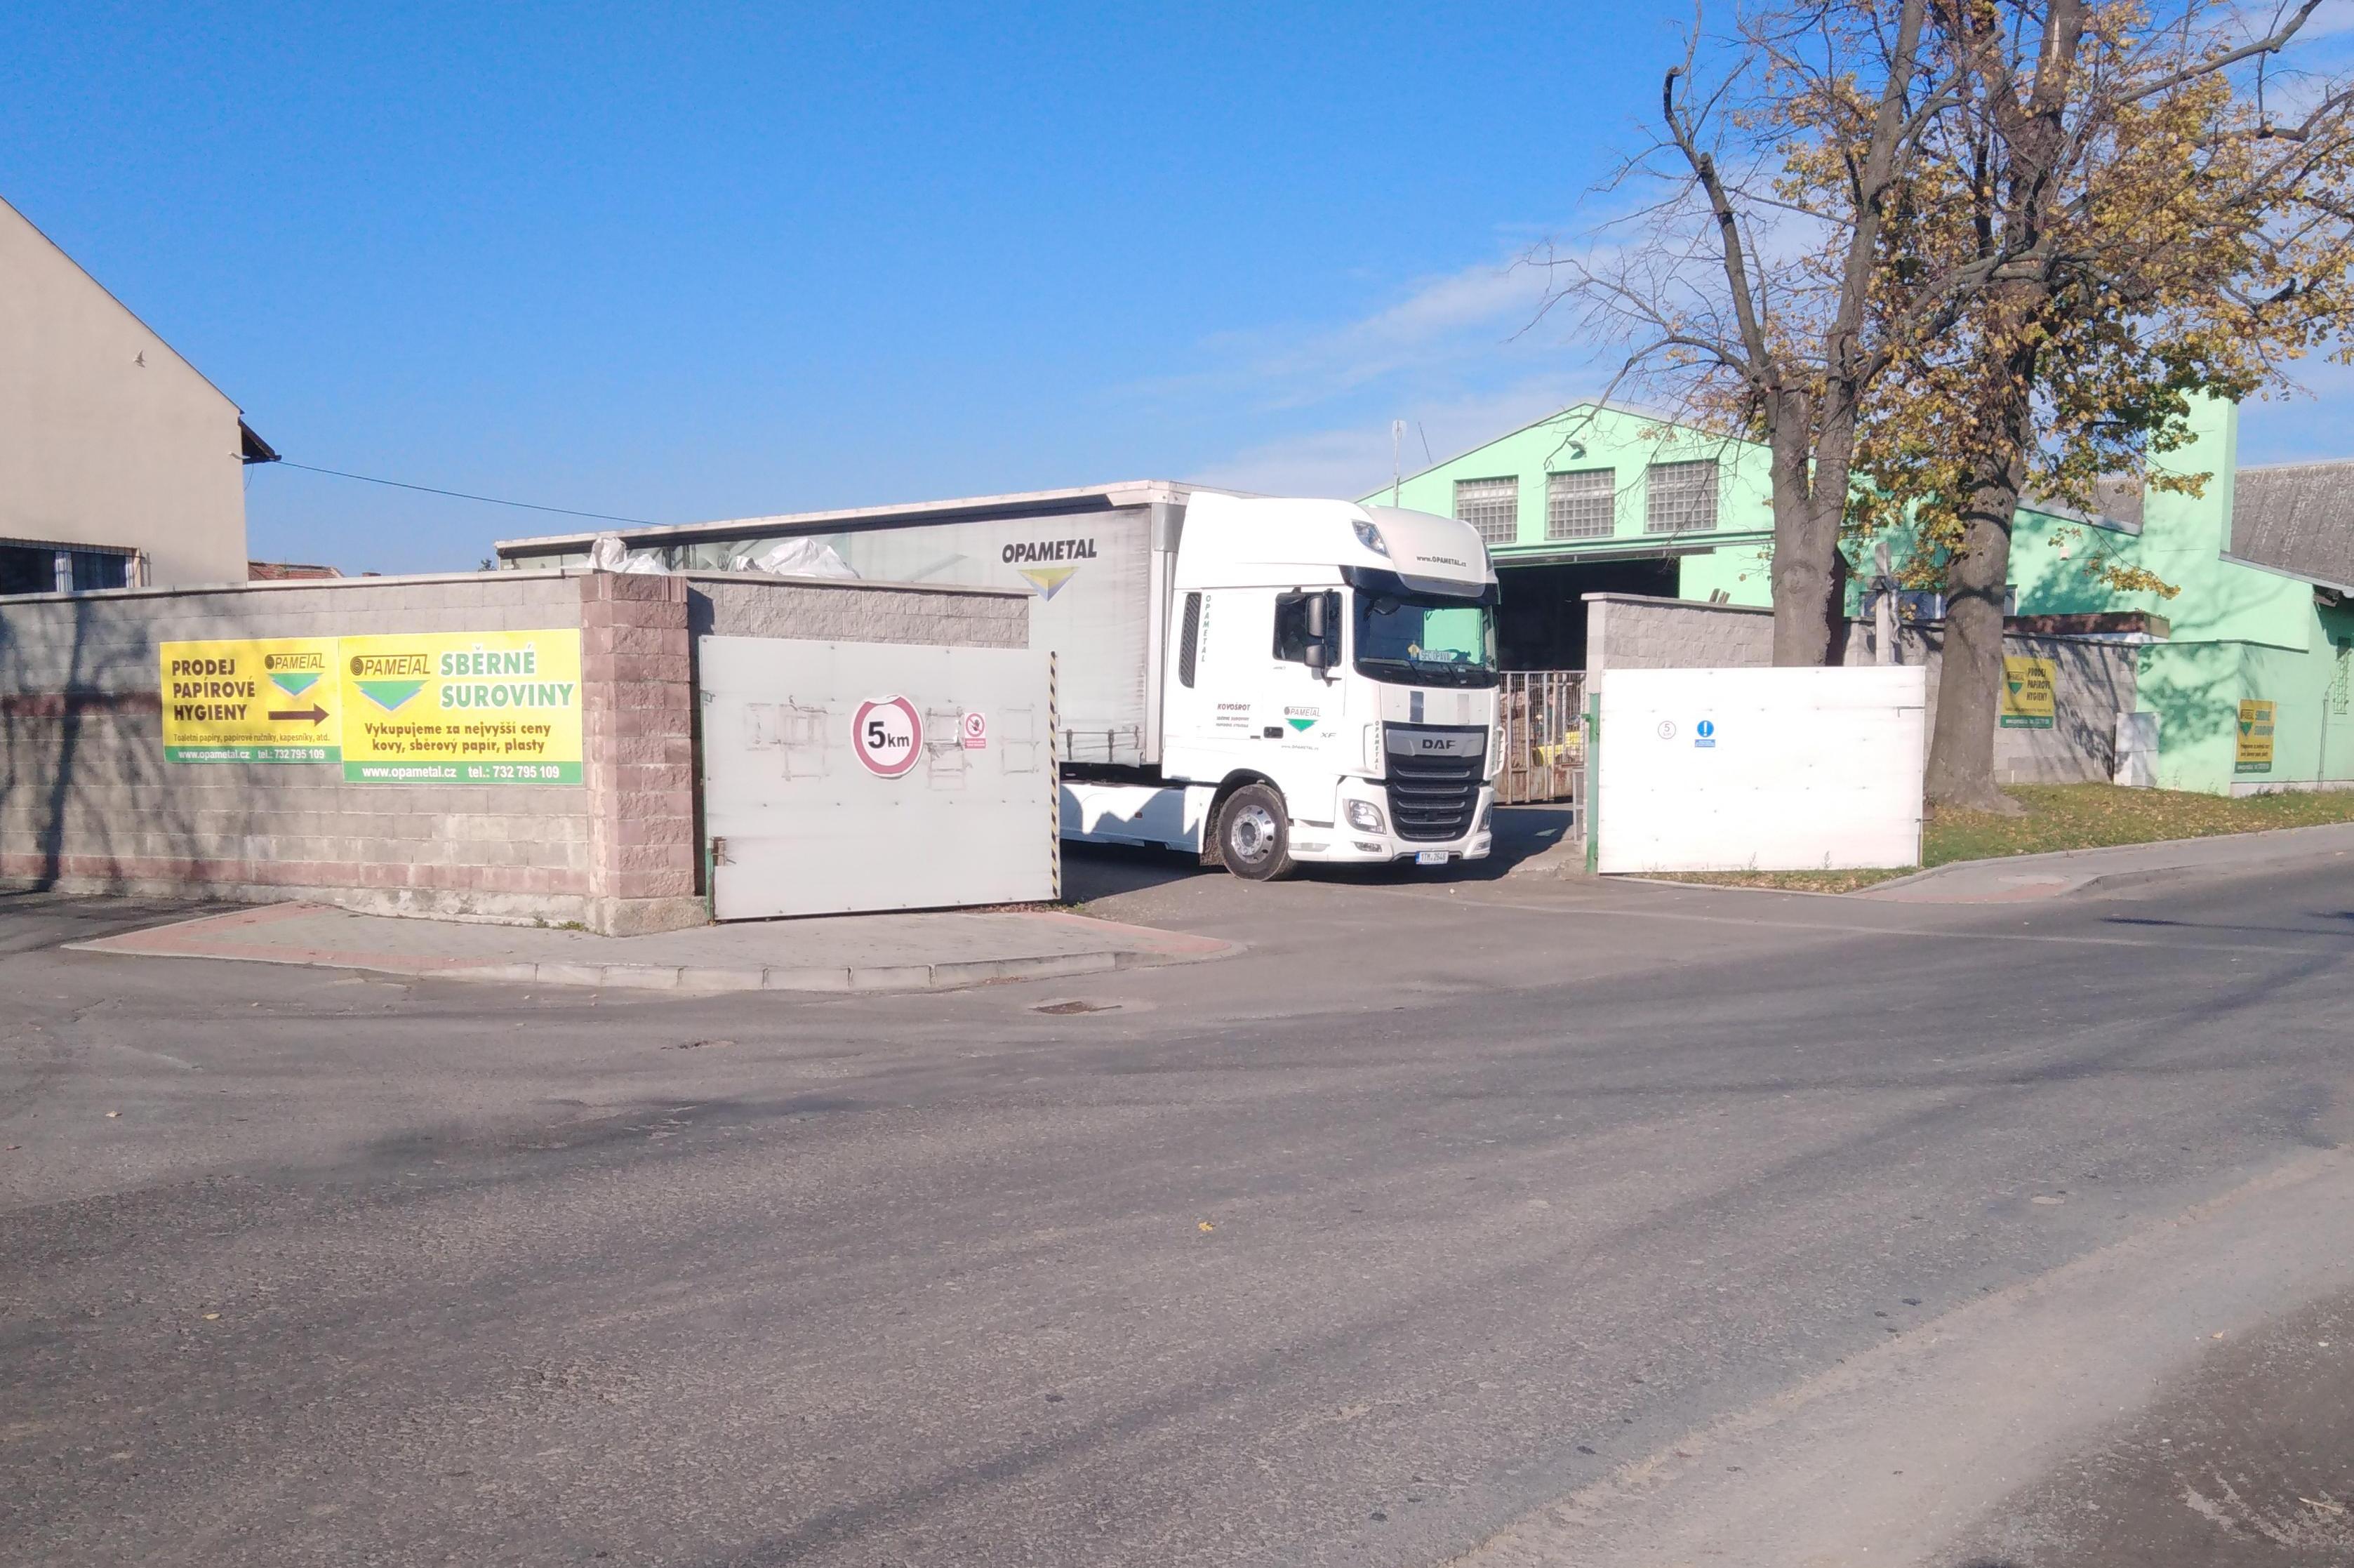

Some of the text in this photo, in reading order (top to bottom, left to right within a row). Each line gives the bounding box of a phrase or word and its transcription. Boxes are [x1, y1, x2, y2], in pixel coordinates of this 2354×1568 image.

[1002, 538, 1097, 563] OPAMETAL
[1202, 594, 1211, 662] OPAMETAL
[172, 658, 235, 676] PRODEJ
[265, 653, 325, 670] OPAMETAL
[350, 654, 430, 676] OPAMETAL
[441, 644, 535, 675] SBĚRNÉ
[173, 676, 255, 698] PAPÍROVÉ
[441, 684, 574, 707] SUROVINY
[173, 704, 248, 721] HYGIENY
[1284, 706, 1321, 717] OPAMETAL
[317, 733, 330, 741] atd.
[364, 722, 551, 737] Vykupujeme za nejvyšší ceny
[372, 738, 545, 754] kovy, sběrový papír, plasty
[1422, 739, 1456, 750] DAF
[178, 750, 251, 760] www.opametal.cz
[274, 749, 291, 759] 732
[291, 749, 307, 759] 795
[309, 749, 324, 759] 109
[362, 766, 559, 780] www.opametal.cz tel.: 732 795 109
